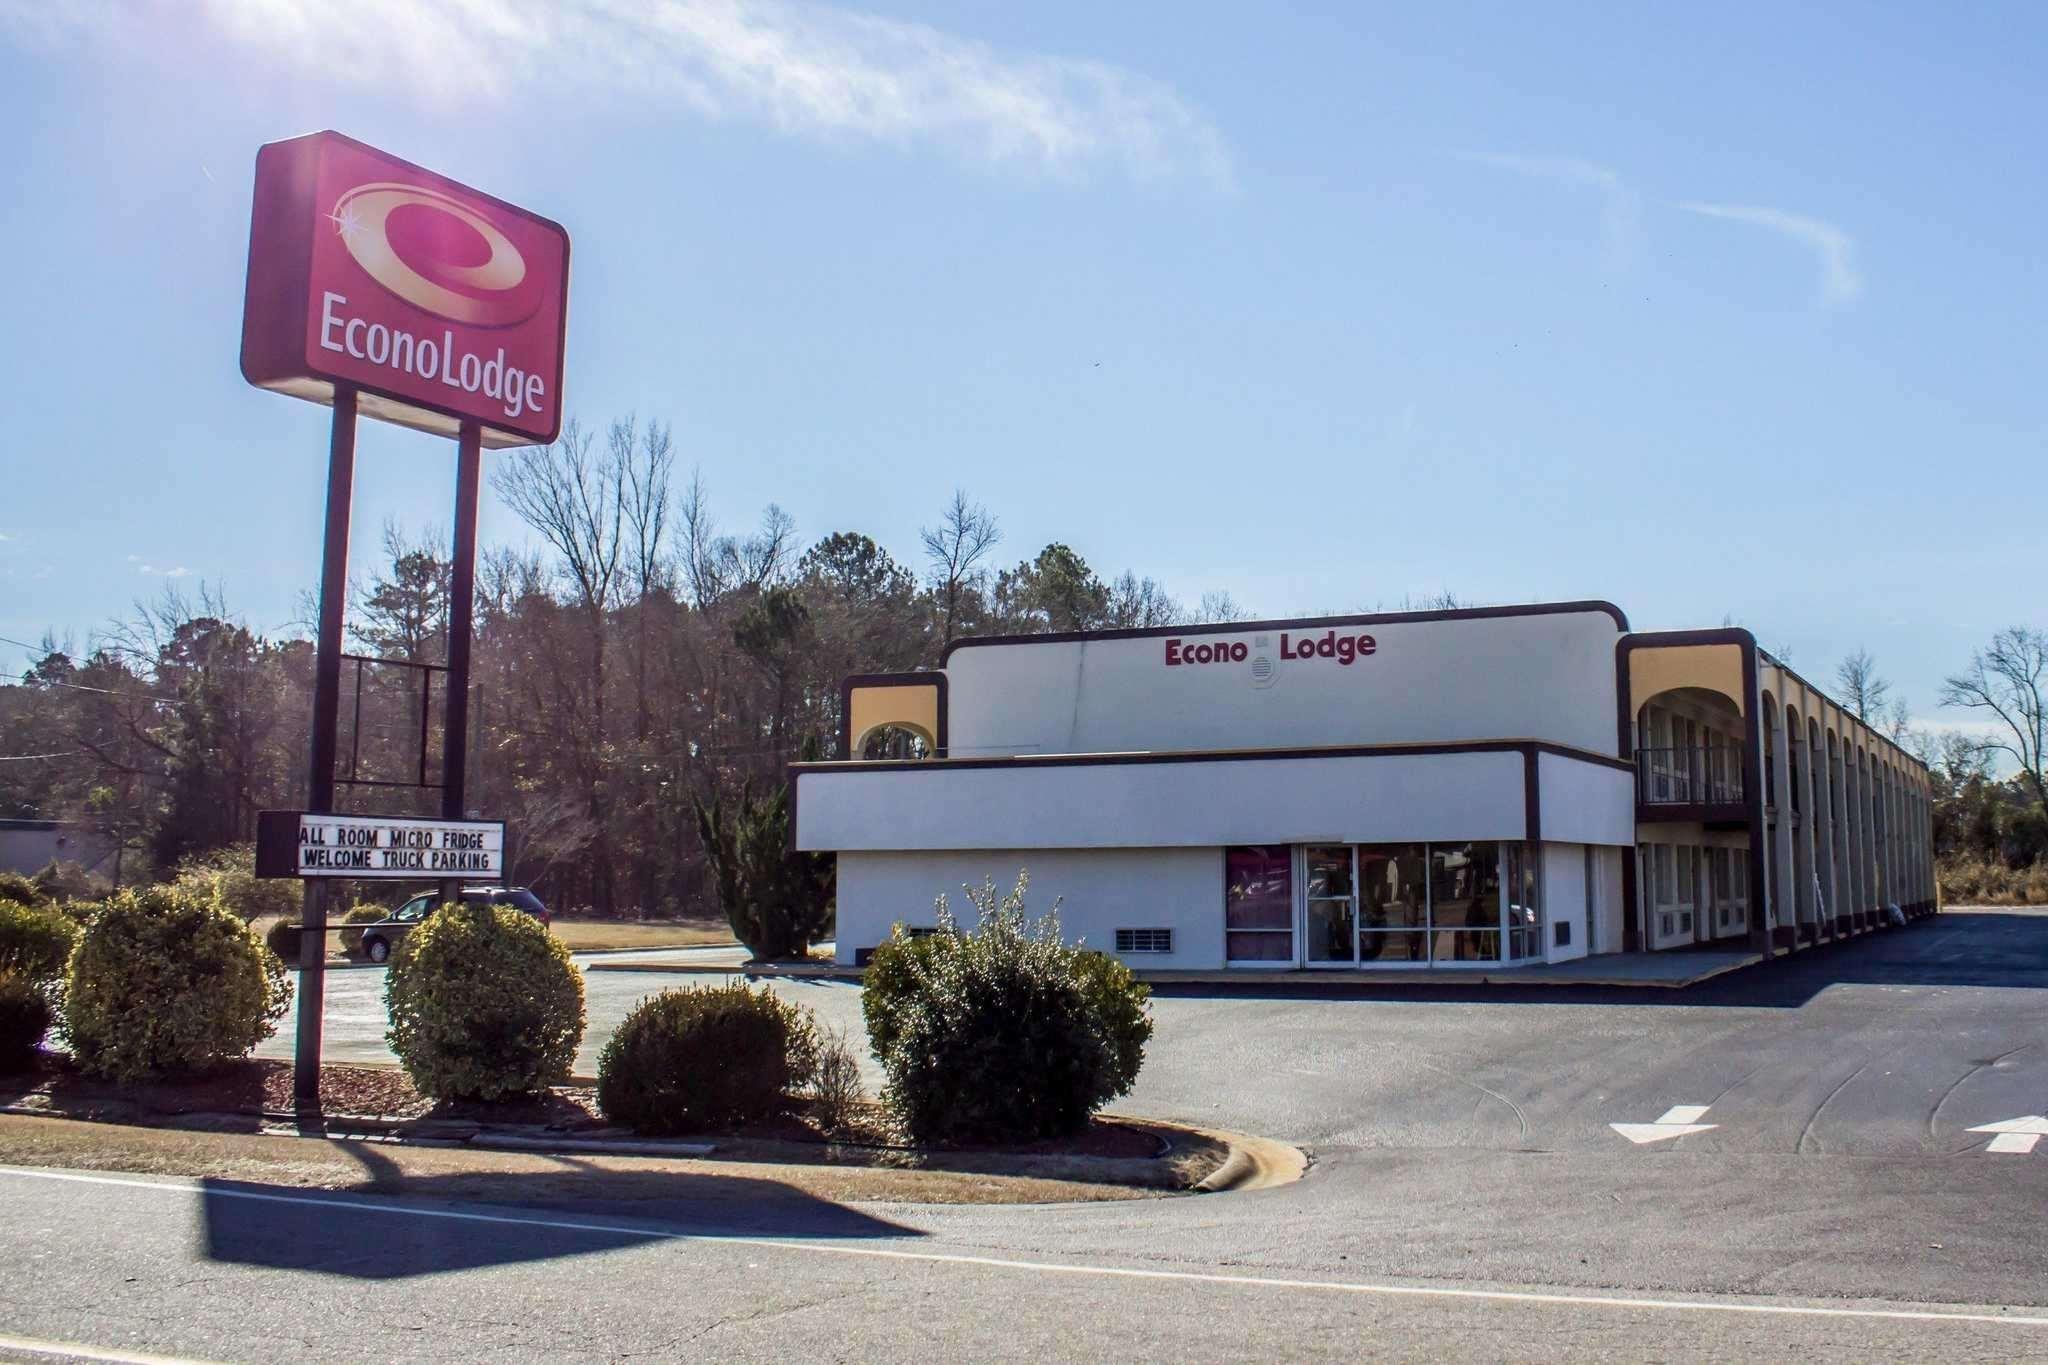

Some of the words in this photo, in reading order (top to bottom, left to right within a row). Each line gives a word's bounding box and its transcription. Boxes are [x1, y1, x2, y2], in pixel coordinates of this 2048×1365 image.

[320, 291, 545, 418] EconoLodge
[1166, 639, 1248, 666] Econo
[1281, 631, 1376, 665] Lodge
[299, 828, 325, 844] ALL
[338, 829, 378, 847] ROOM
[390, 831, 433, 848] MICRO
[443, 832, 484, 849] FRIDGE
[304, 849, 372, 867] WELCOME
[382, 851, 424, 868] TRUCK
[431, 852, 489, 869] PARKING
